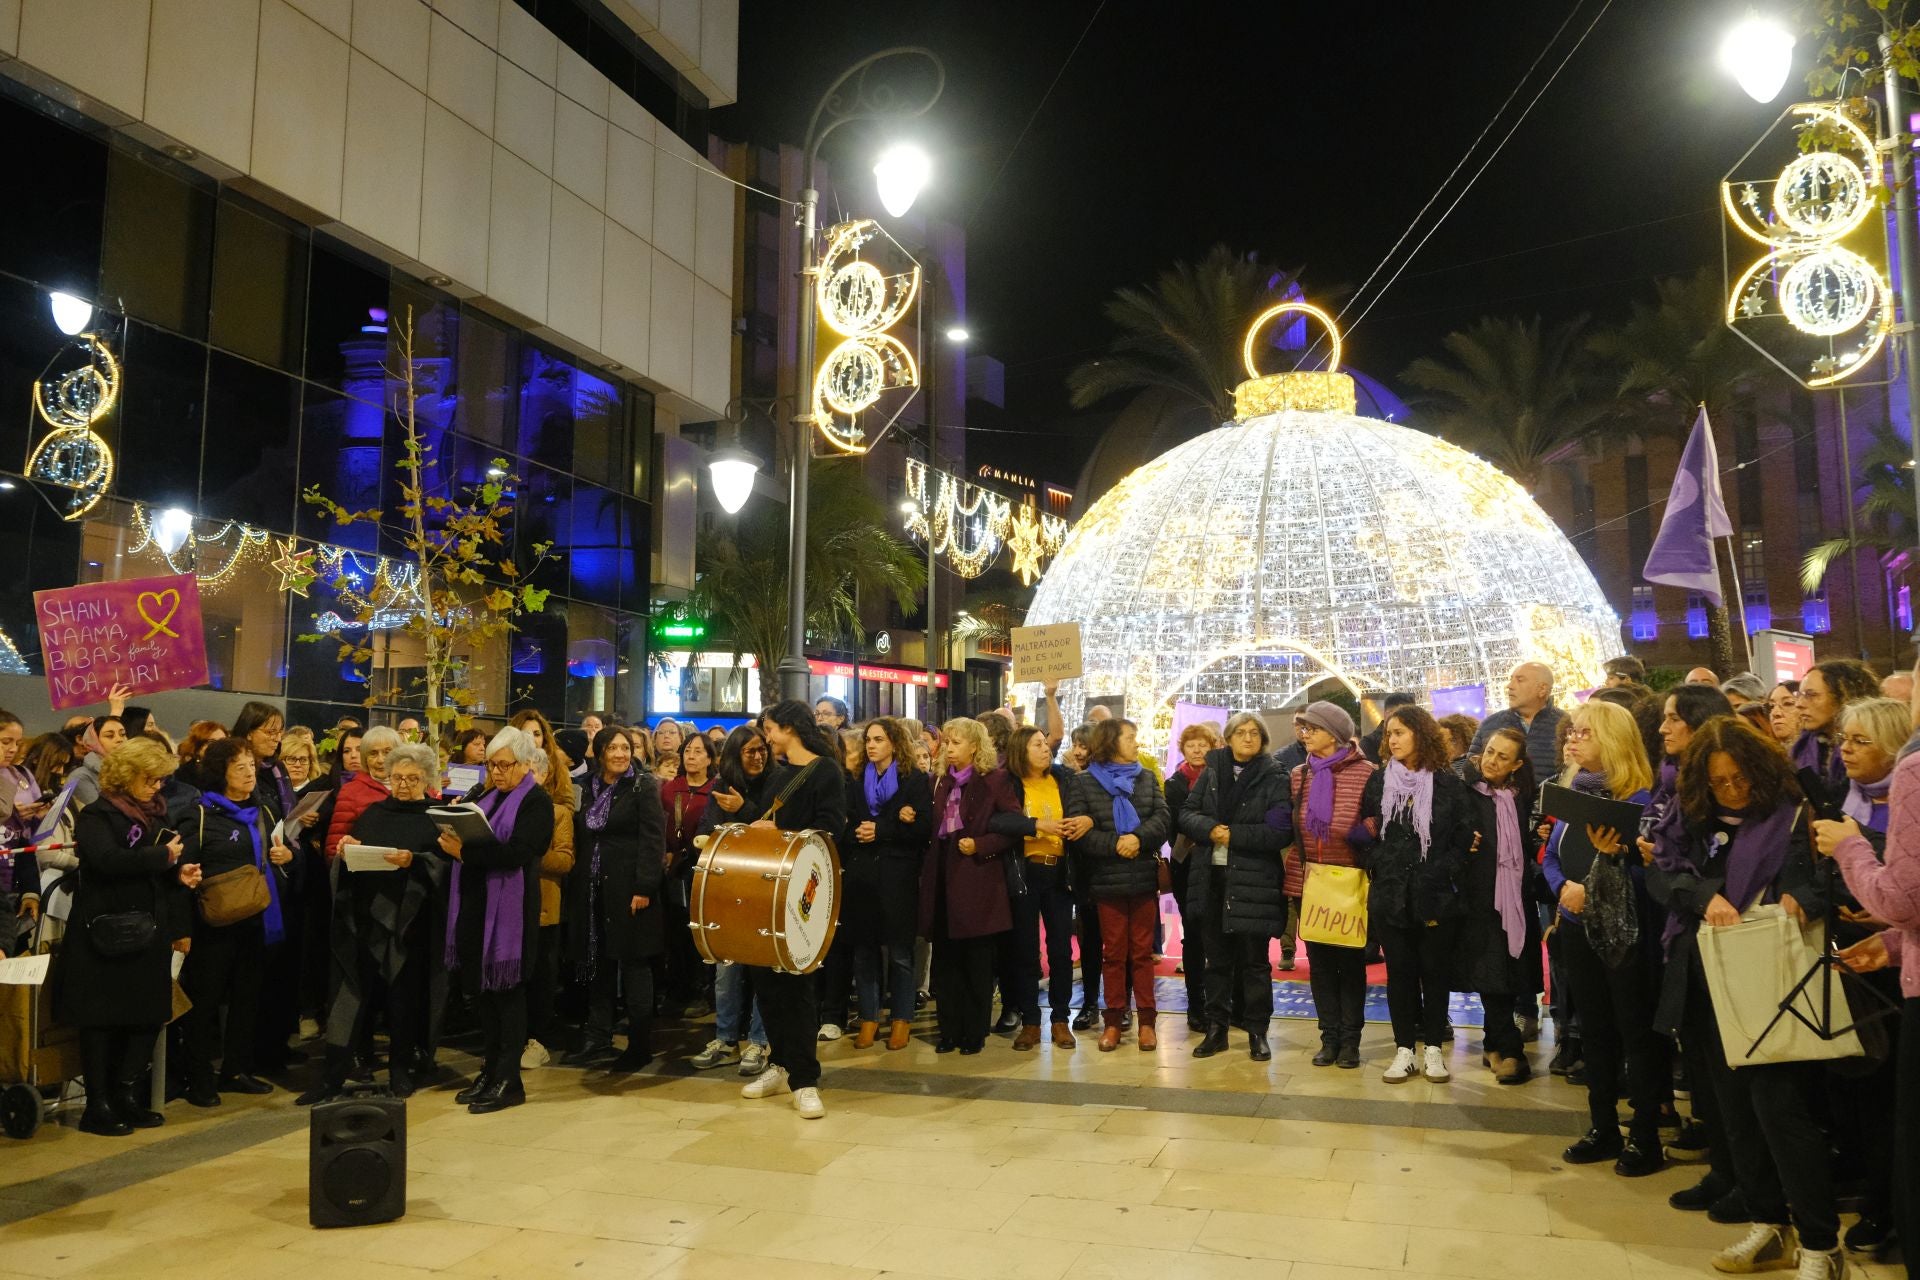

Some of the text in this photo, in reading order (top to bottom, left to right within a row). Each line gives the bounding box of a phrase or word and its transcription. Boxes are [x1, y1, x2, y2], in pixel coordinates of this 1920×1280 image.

[42, 598, 118, 627] SHANI,
[43, 623, 128, 648] NAAMA,
[1015, 638, 1071, 652] MALTRATADOR
[49, 640, 167, 672] BIBAS family,
[1020, 655, 1031, 664] NO
[1036, 653, 1046, 661] ES
[834, 665, 868, 677] MEDICNA
[869, 668, 898, 680] ESTÉTICA
[1020, 663, 1072, 675] BUEN PADRE
[54, 671, 107, 698] NOA,
[115, 664, 160, 688] LIRI
